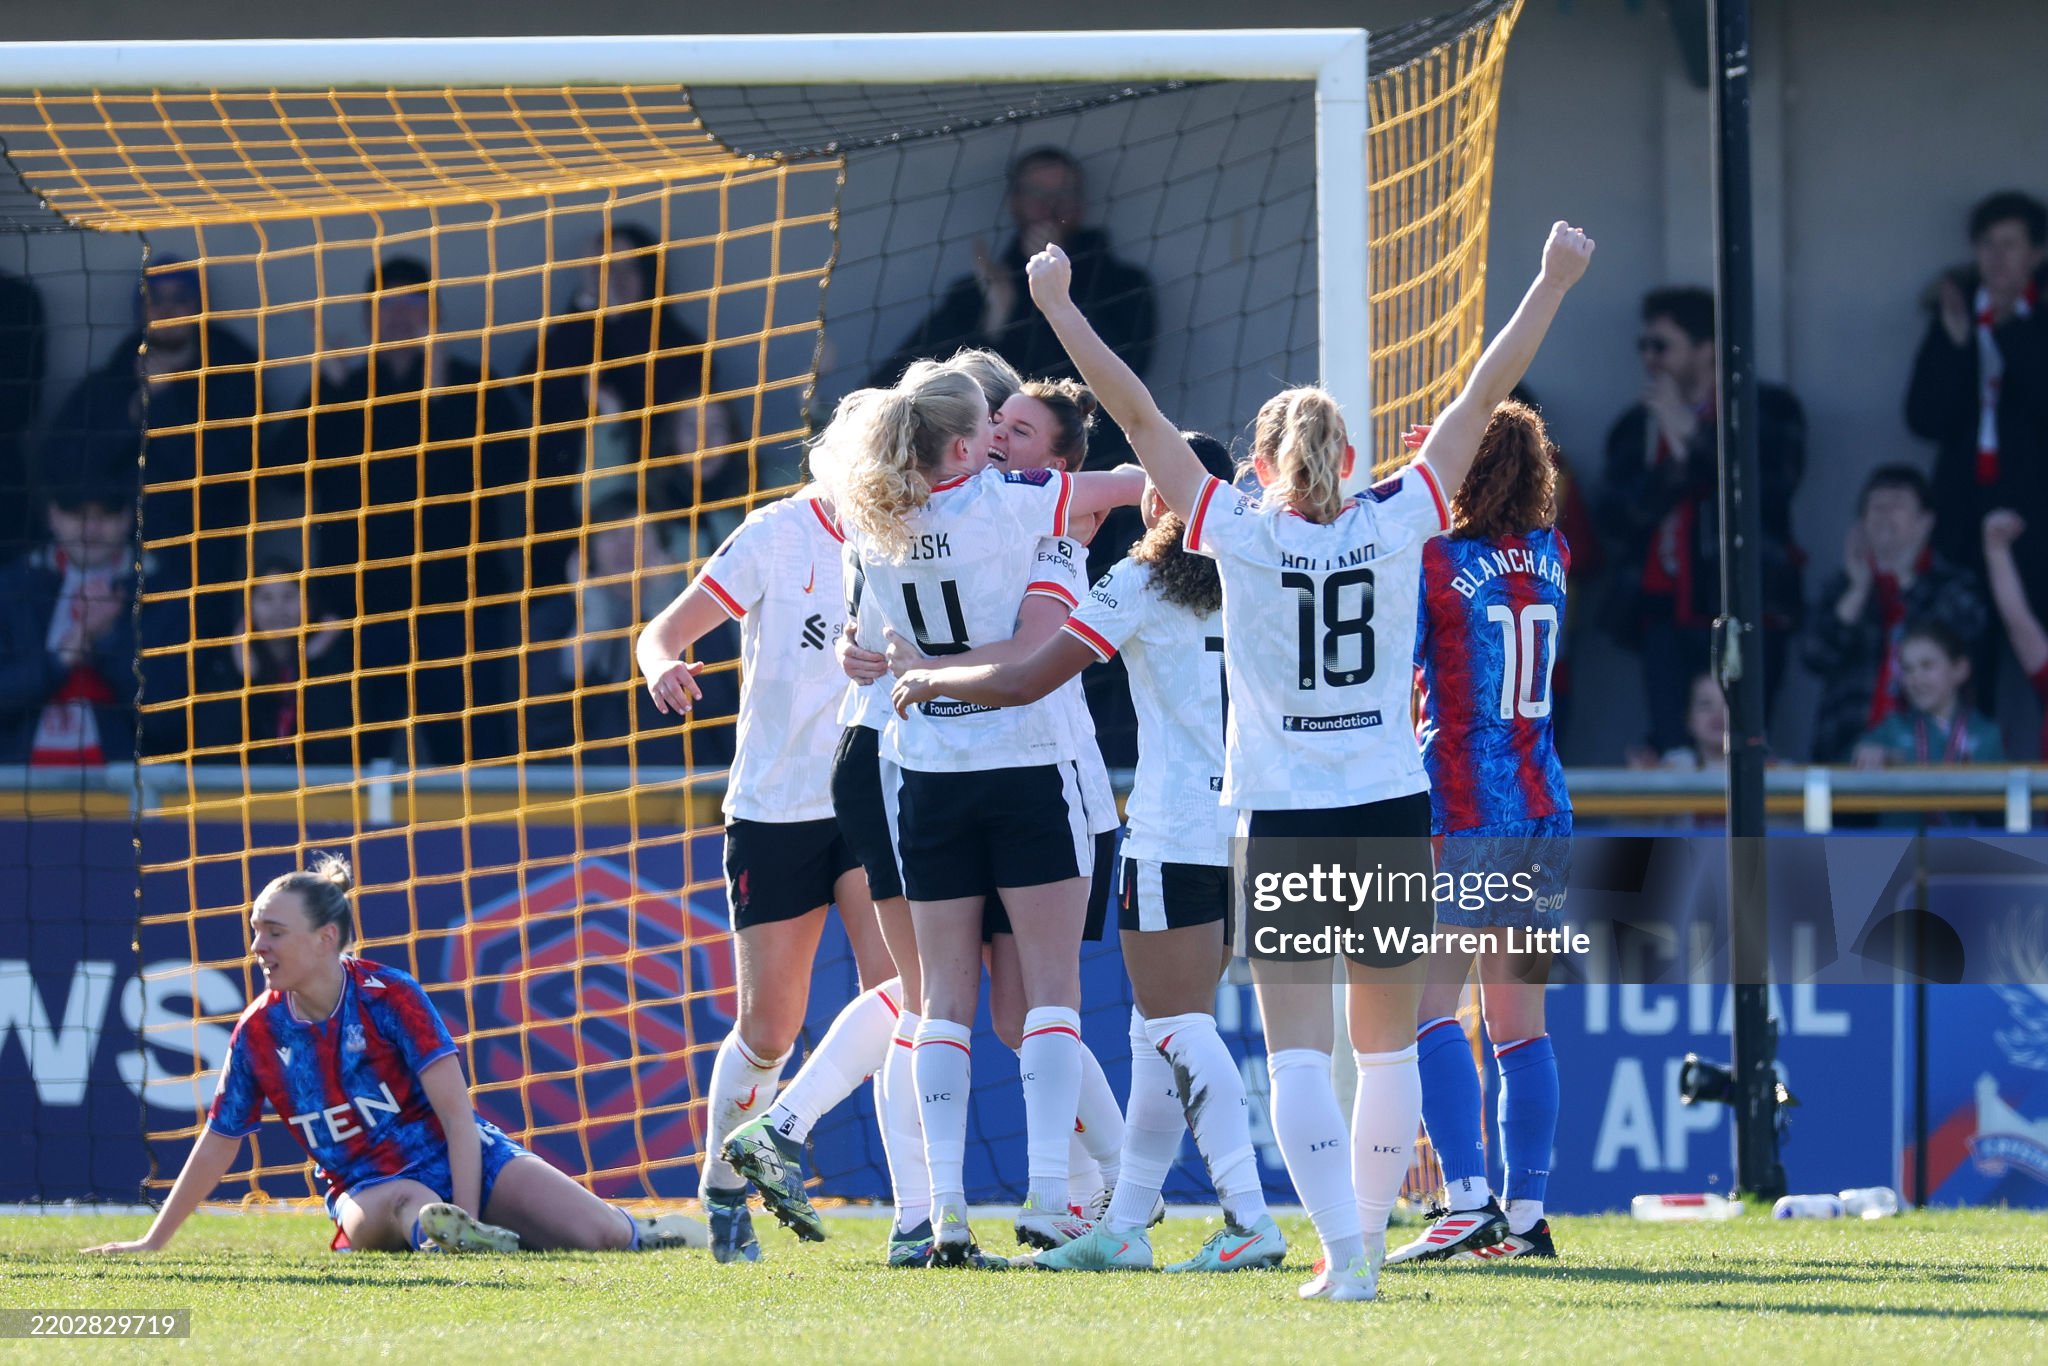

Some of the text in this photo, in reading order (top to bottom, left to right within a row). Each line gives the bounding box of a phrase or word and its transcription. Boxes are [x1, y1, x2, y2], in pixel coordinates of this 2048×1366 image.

[908, 532, 951, 560] ISK
[1088, 590, 1118, 609] edia
[901, 579, 972, 656] 4
[1281, 568, 1376, 690] 18
[1486, 604, 1558, 720] 10
[1300, 714, 1379, 730] Foundation
[0, 957, 260, 1112] WS
[925, 1092, 952, 1103] LFC
[288, 1081, 401, 1149] TEN
[1310, 1139, 1339, 1153] LFC
[1373, 1145, 1402, 1154] LFC
